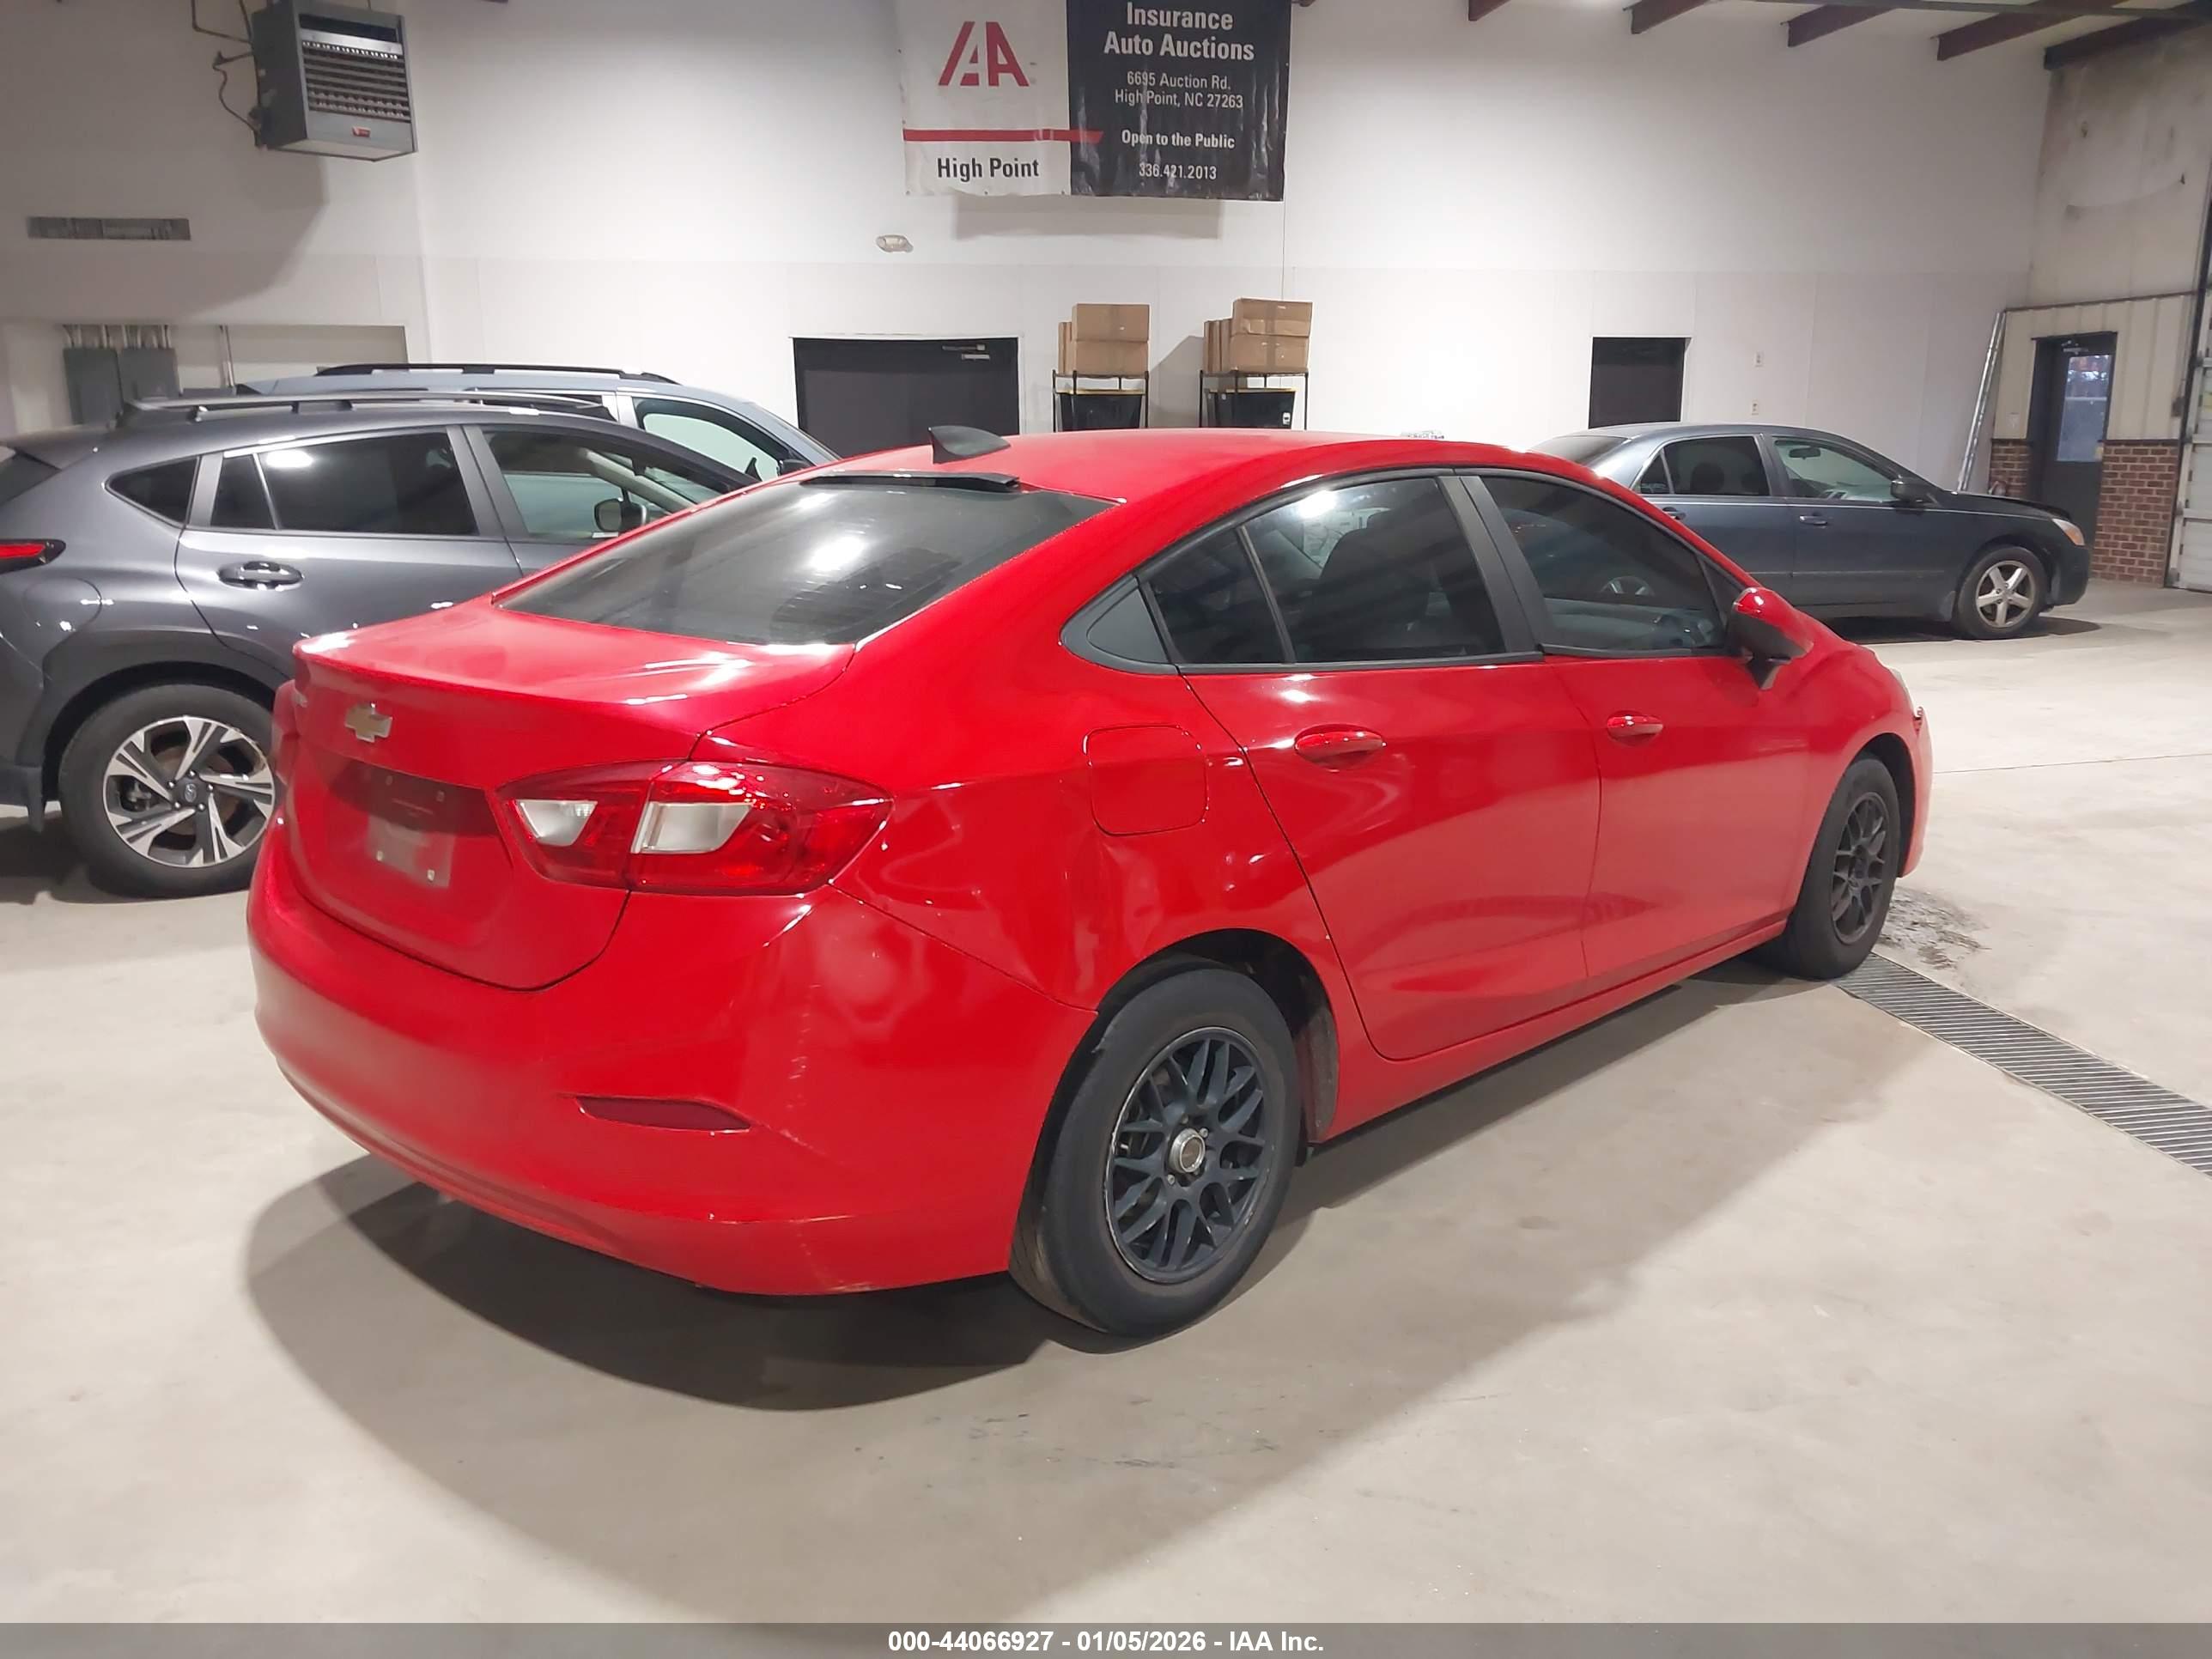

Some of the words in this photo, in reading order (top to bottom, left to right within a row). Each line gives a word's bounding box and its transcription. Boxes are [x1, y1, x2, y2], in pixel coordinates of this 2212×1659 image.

[1127, 2, 1234, 31] Insurance
[1103, 31, 1154, 56] Auto
[1159, 33, 1255, 61] Auctions
[1127, 70, 1156, 86] 6695
[1159, 73, 1207, 88] Auction
[1212, 75, 1231, 90] Rd.
[1115, 88, 1144, 106] High
[1146, 90, 1181, 107] Point,
[1184, 92, 1203, 106] NC
[1206, 94, 1243, 108] 27263
[1121, 130, 1153, 147] Open
[1156, 133, 1169, 146] to
[1171, 132, 1192, 147] the
[1194, 133, 1236, 149] Public
[937, 157, 982, 182] High
[989, 157, 1039, 178] Point
[1139, 162, 1217, 179] 336.421.2013
